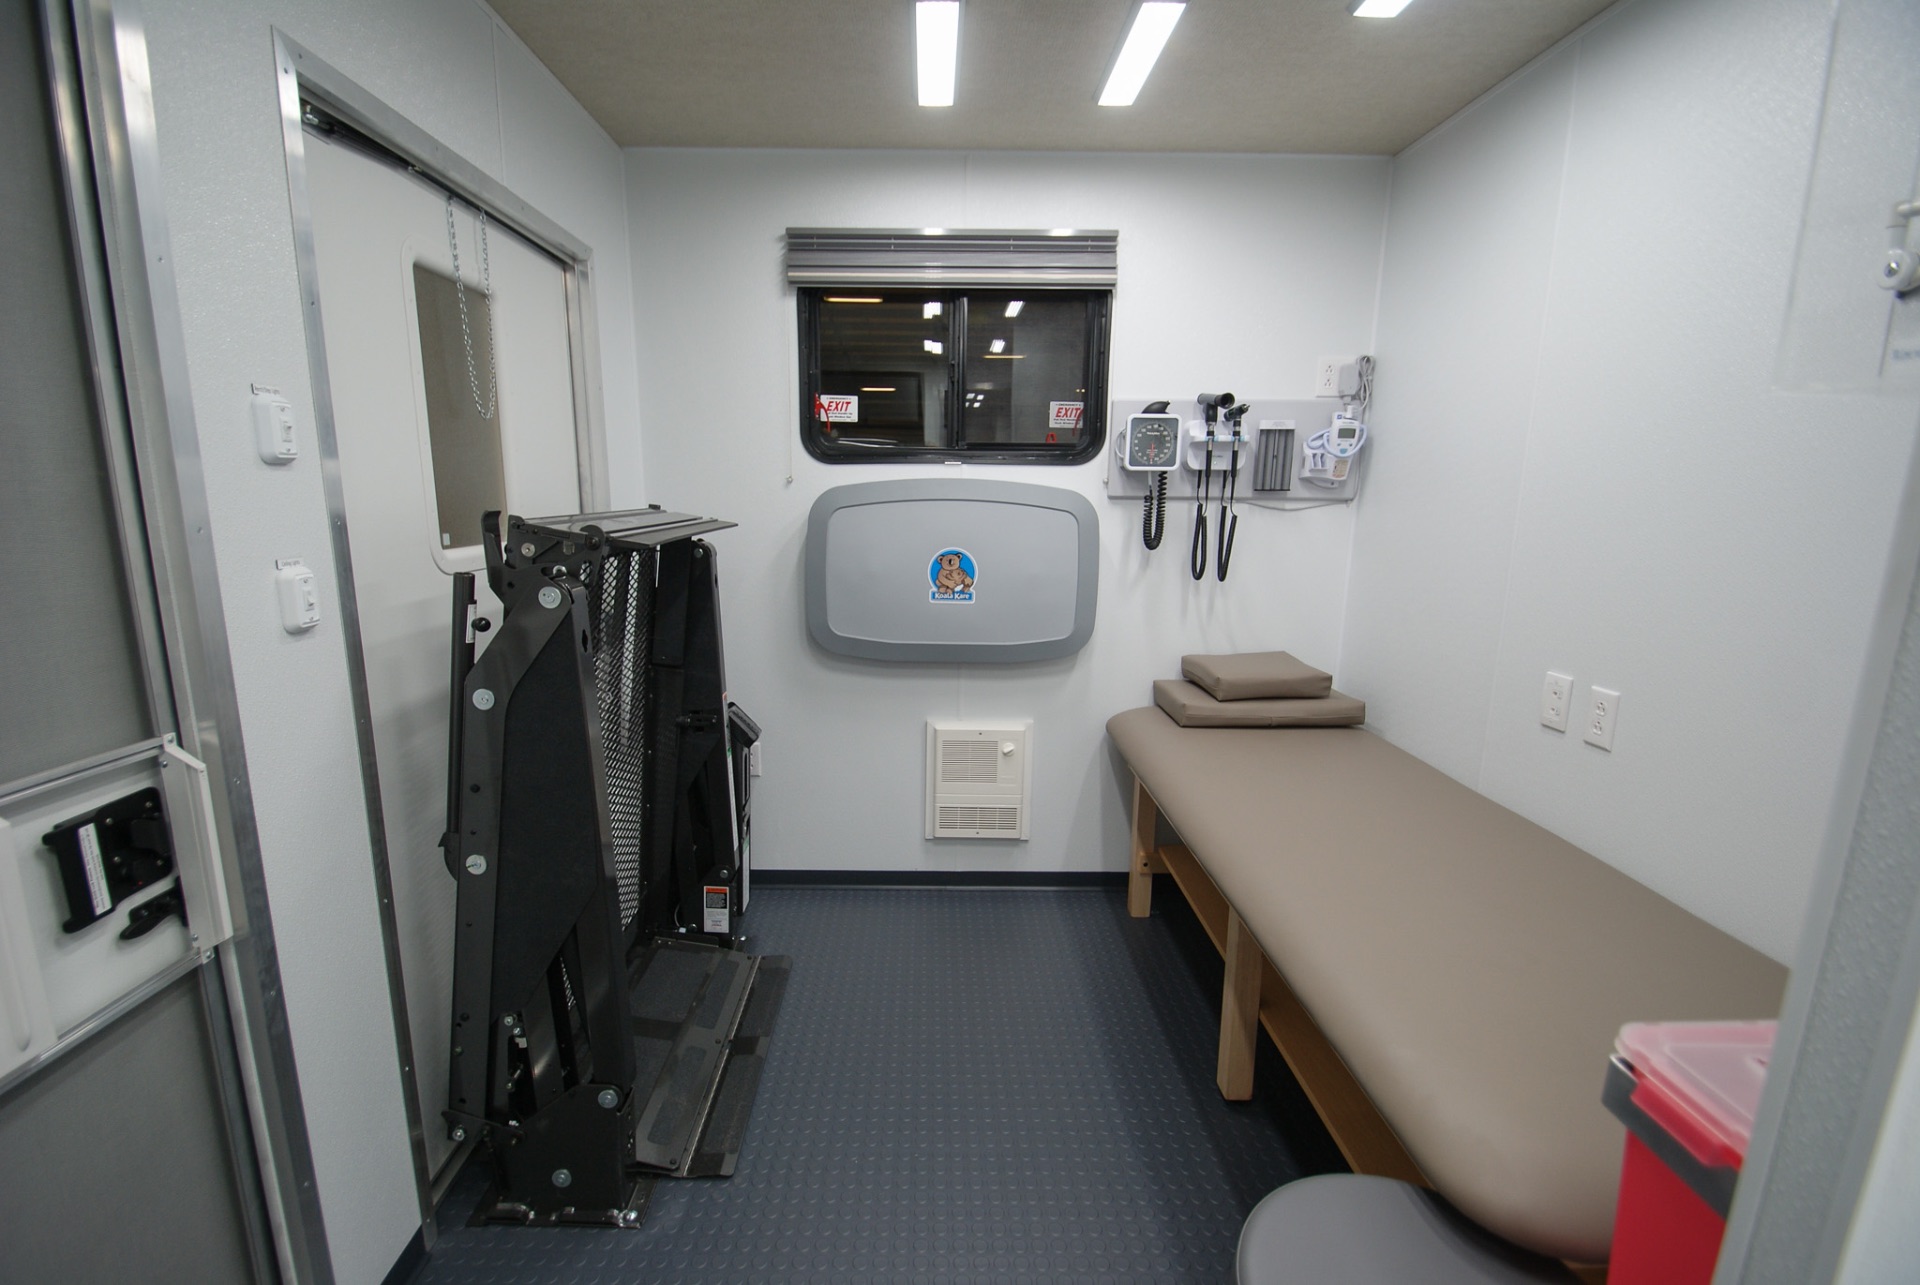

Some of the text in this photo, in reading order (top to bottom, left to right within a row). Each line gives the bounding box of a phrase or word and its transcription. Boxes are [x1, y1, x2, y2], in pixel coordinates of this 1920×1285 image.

[827, 401, 851, 412] EXIT
[1055, 407, 1081, 418] EXIT
[954, 592, 970, 600] Kare
